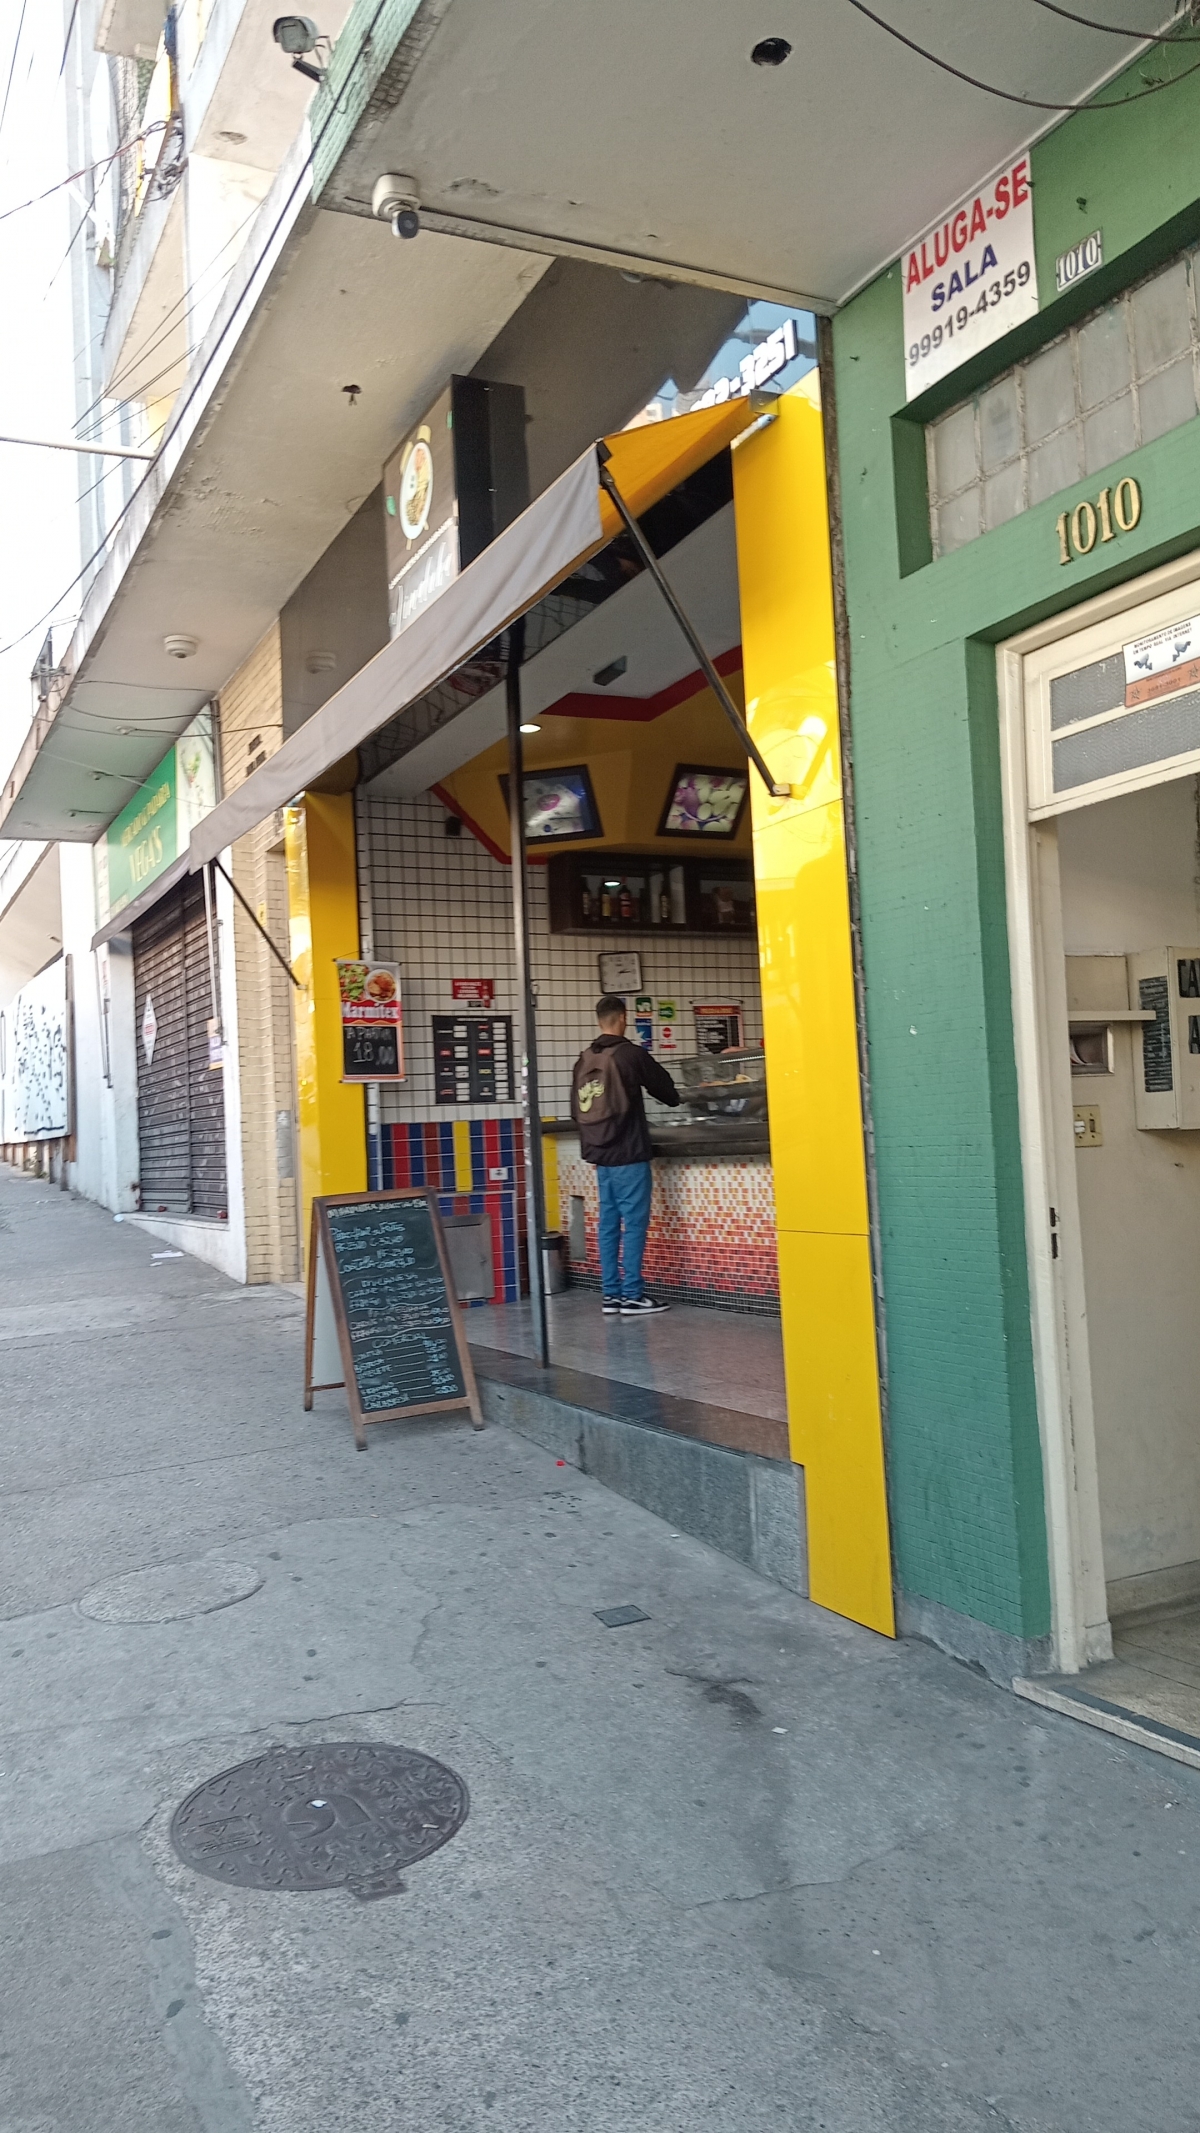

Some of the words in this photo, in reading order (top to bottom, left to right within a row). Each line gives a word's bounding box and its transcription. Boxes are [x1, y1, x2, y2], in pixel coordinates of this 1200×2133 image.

[906, 159, 1029, 294] ALUGA-SE
[1057, 237, 1099, 285] 1010
[909, 261, 1031, 367] 99919-4359
[931, 243, 998, 312] SALA
[1055, 476, 1141, 566] 1010
